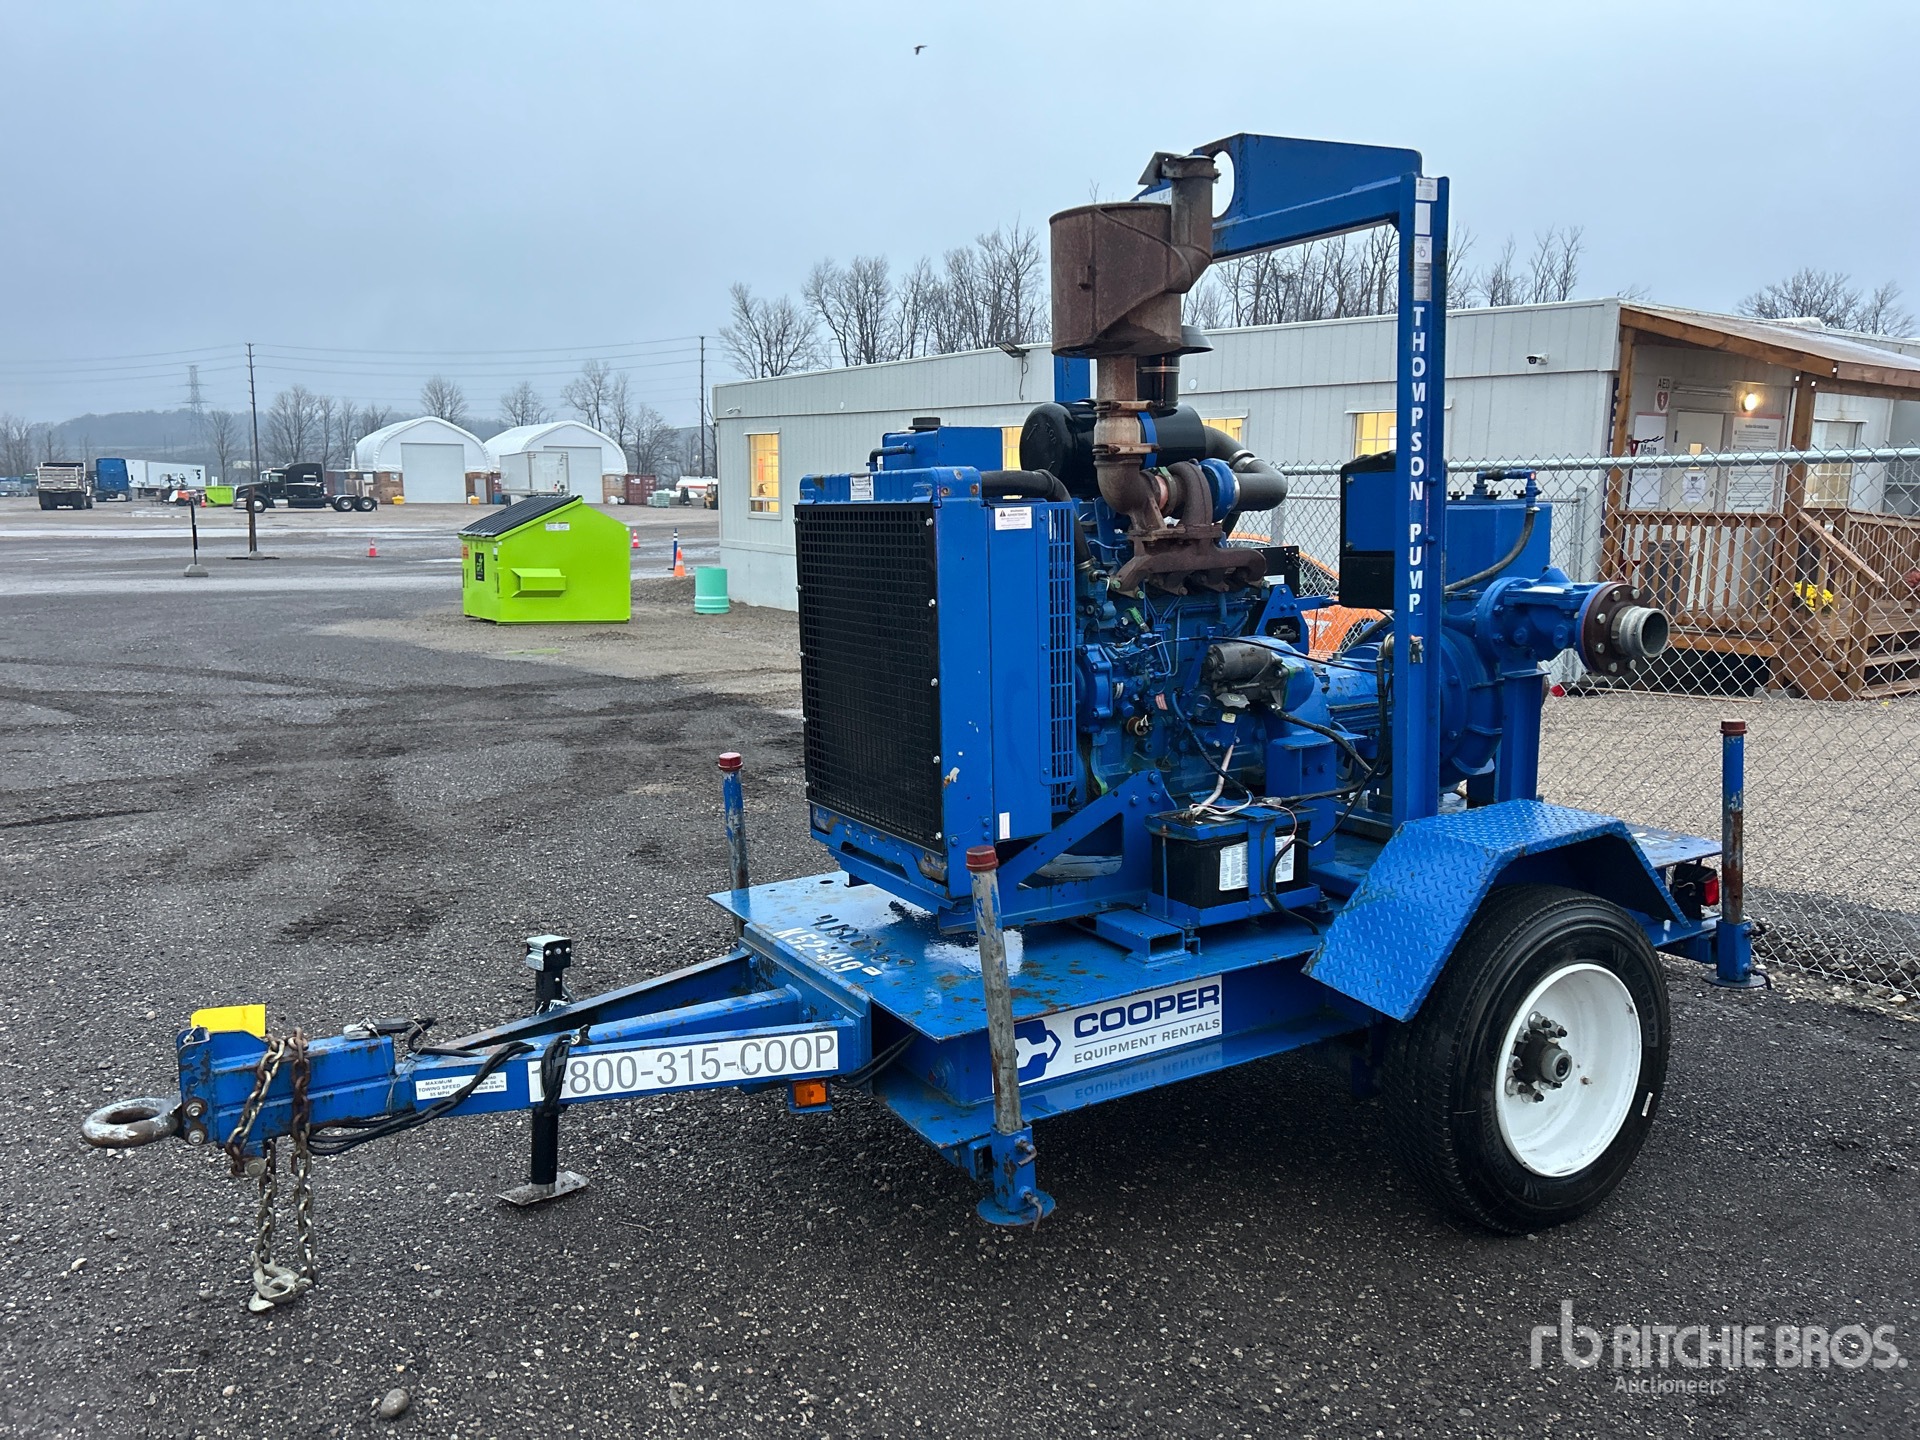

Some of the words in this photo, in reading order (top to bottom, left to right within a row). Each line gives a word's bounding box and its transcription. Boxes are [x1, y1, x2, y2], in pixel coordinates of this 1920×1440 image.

[1410, 306, 1426, 501] THOMPSON
[1657, 378, 1670, 390] AED
[1640, 444, 1657, 455] Main
[1409, 523, 1423, 612] PUMP
[1074, 984, 1220, 1038] COOPER
[532, 1034, 837, 1098] 1800-315-COOP
[1074, 1034, 1157, 1064] EQUIPMENT
[1162, 1018, 1221, 1042] RENTALS
